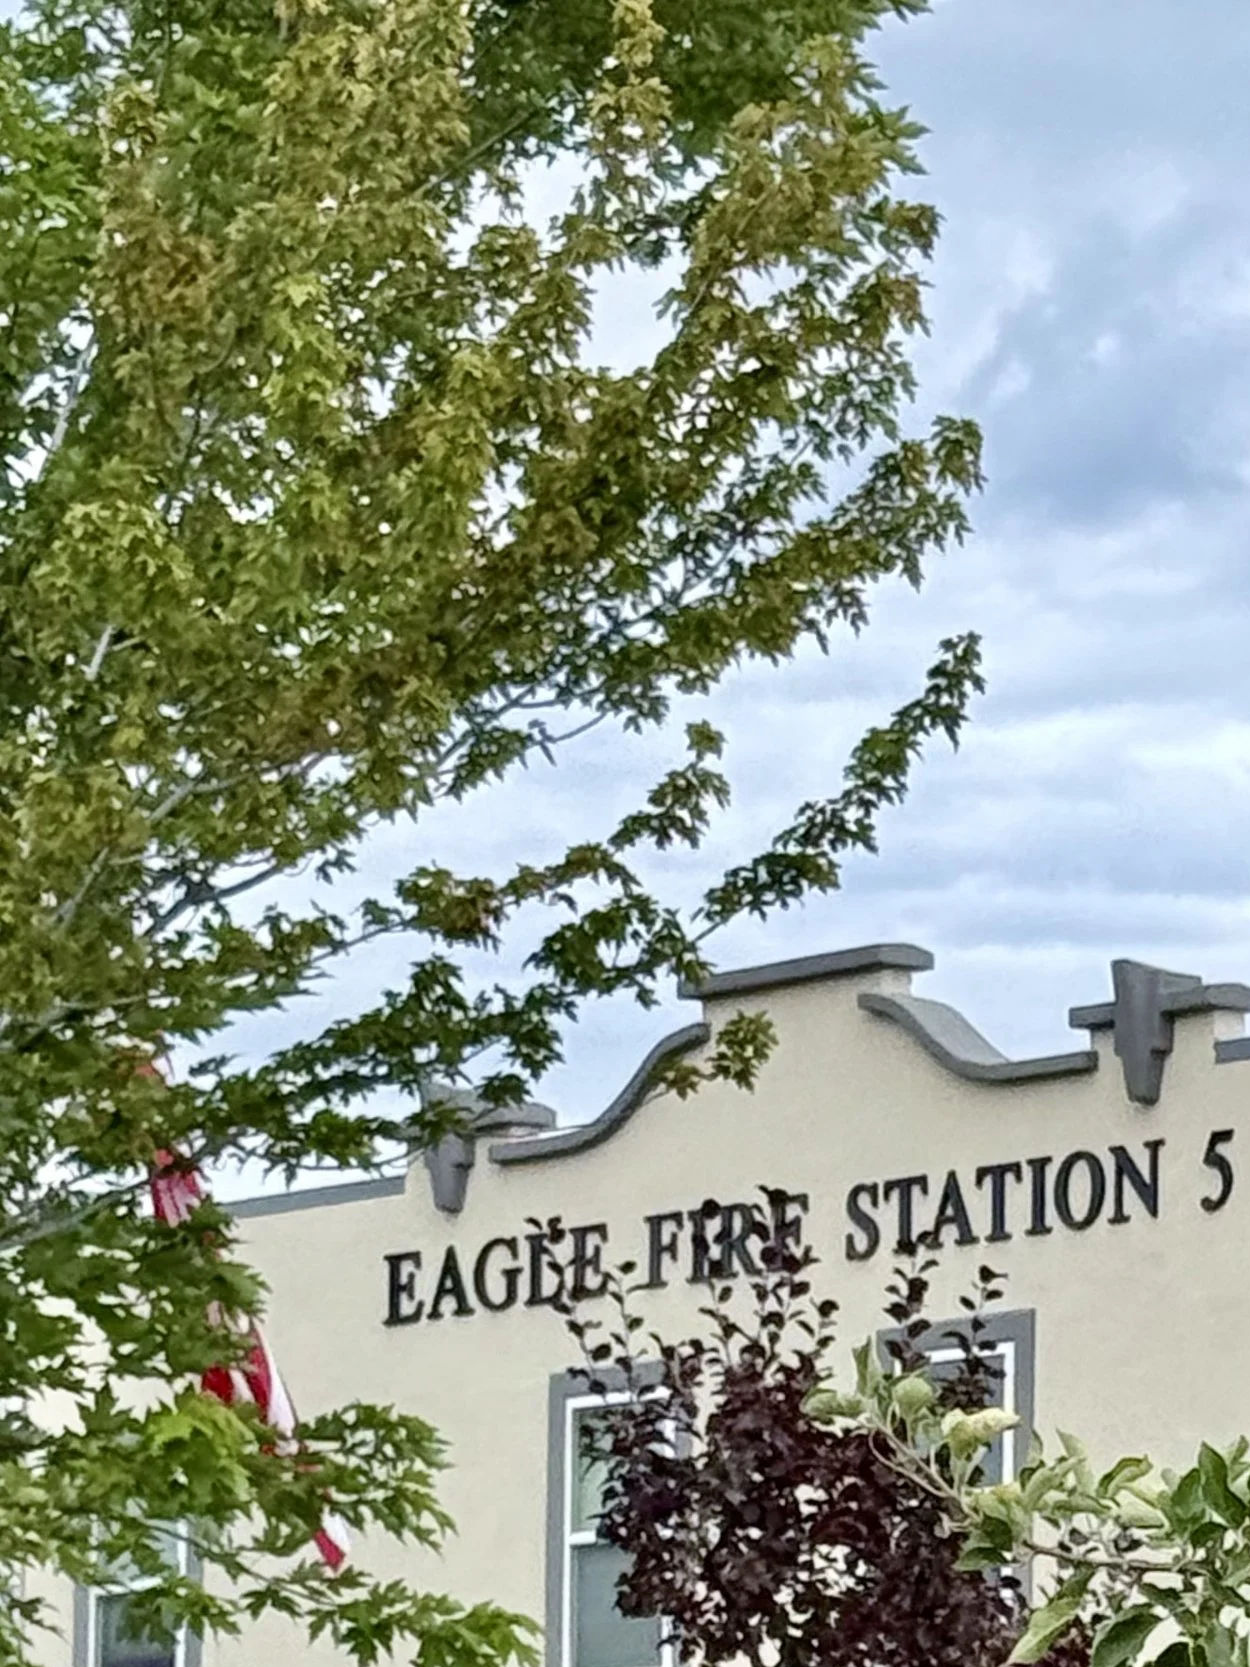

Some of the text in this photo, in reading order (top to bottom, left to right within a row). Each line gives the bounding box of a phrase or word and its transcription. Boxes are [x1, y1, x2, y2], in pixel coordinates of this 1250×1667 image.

[382, 1129, 1235, 1327] EAGLE FIRE STATION 5
